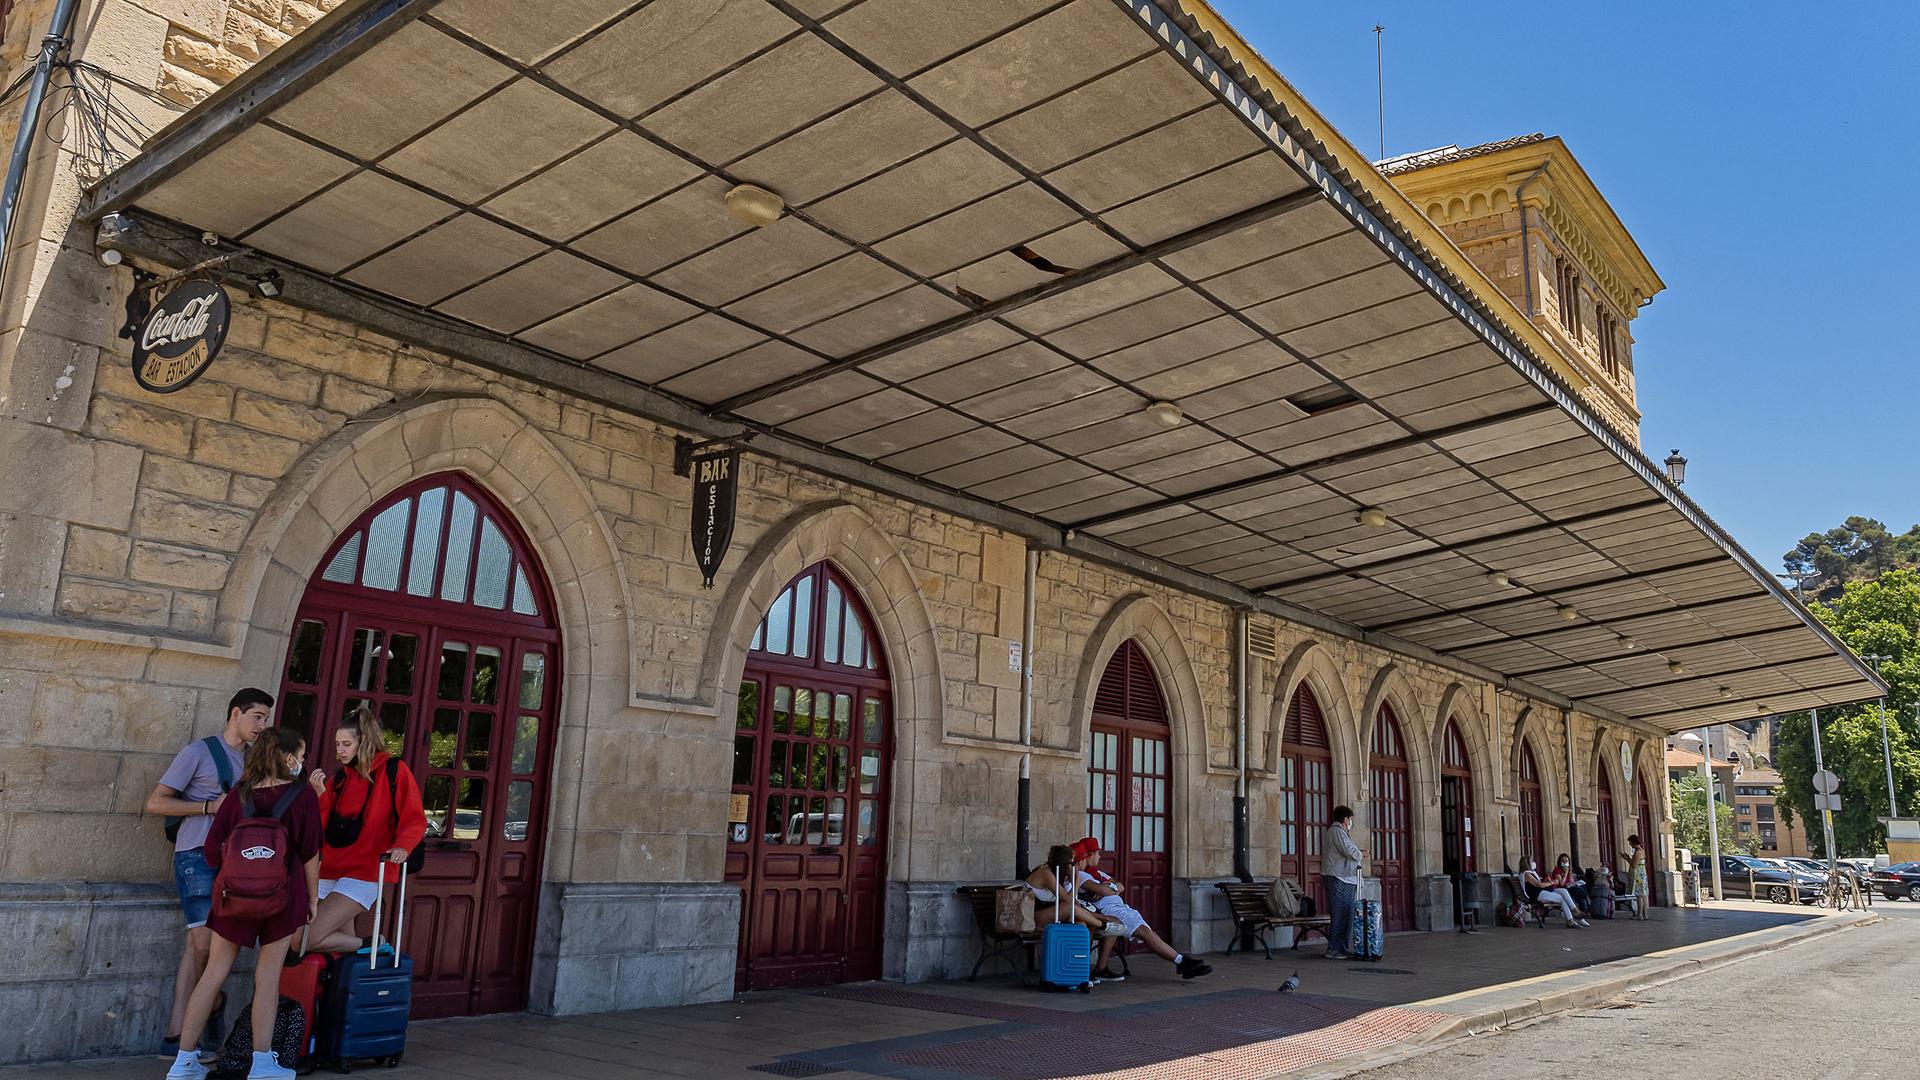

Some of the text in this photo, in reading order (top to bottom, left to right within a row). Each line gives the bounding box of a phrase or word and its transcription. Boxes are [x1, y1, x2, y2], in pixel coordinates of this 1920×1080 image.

[146, 348, 200, 382] BAR ESTACION
[700, 457, 730, 483] BAR
